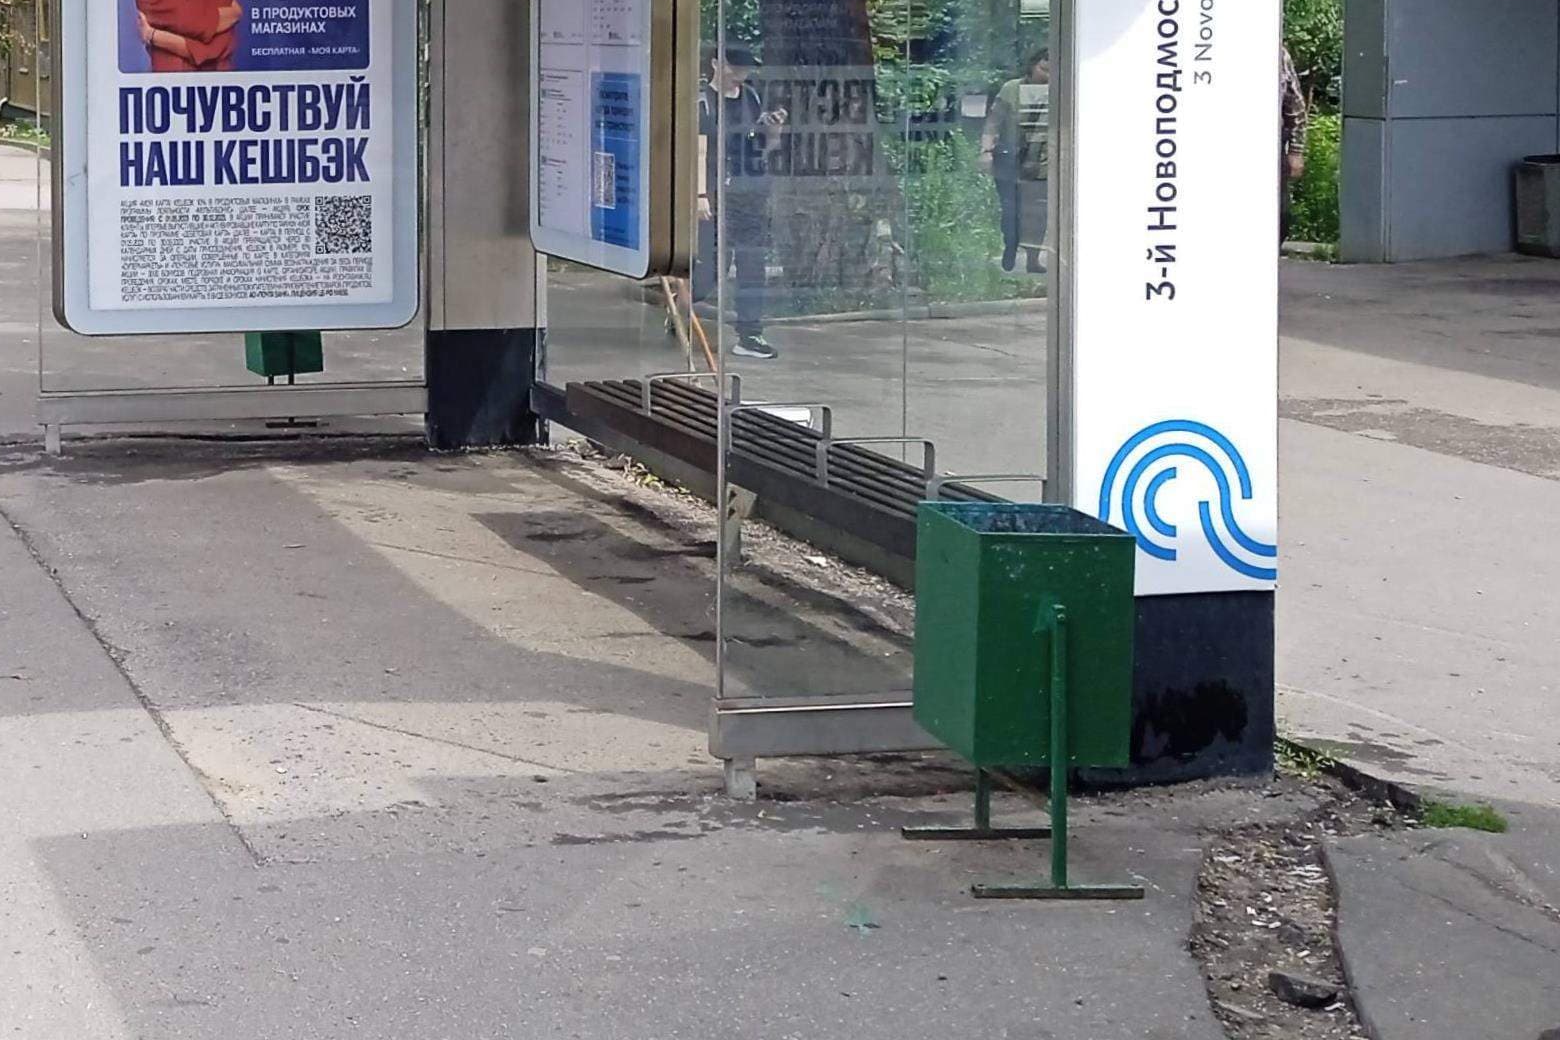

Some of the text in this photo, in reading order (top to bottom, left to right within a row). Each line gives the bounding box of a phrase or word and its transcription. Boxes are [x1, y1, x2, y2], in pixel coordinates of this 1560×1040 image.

[251, 6, 356, 20] В ПРОДУКТОВЫХ
[251, 22, 327, 34] МАГАЗИНАХ
[252, 48, 305, 56] БЕСПЛАТНАЯ
[1194, 70, 1211, 84] 3
[119, 75, 370, 134] ПОЧУВСТВУЙ
[120, 137, 370, 187] НАШ КЕШБЭК
[1146, 245, 1176, 300] 3-й
